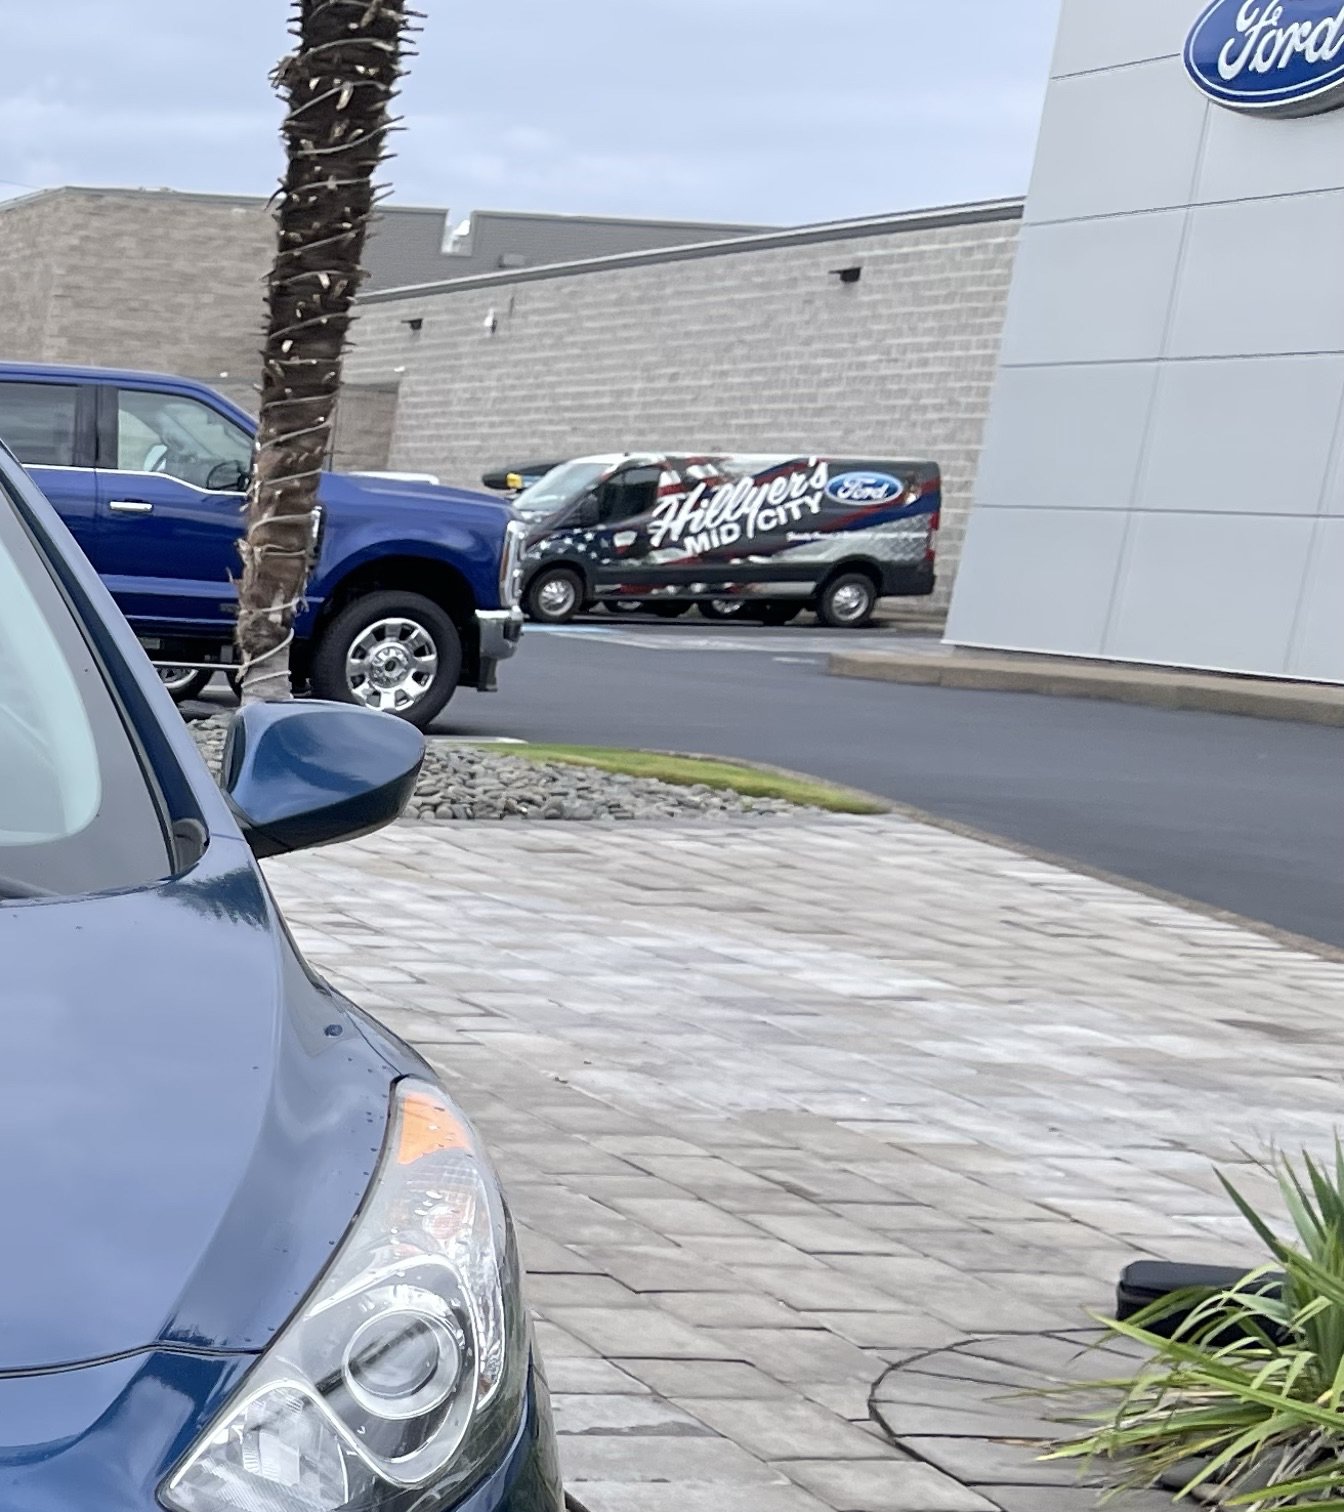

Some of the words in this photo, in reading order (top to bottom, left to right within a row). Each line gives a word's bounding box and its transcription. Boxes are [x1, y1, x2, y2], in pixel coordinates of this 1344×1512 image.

[1218, 0, 1344, 80] Ford
[646, 456, 829, 548] Hillyer's
[683, 522, 742, 557] MID
[757, 491, 823, 532] CITY
[837, 477, 891, 500] Ford
